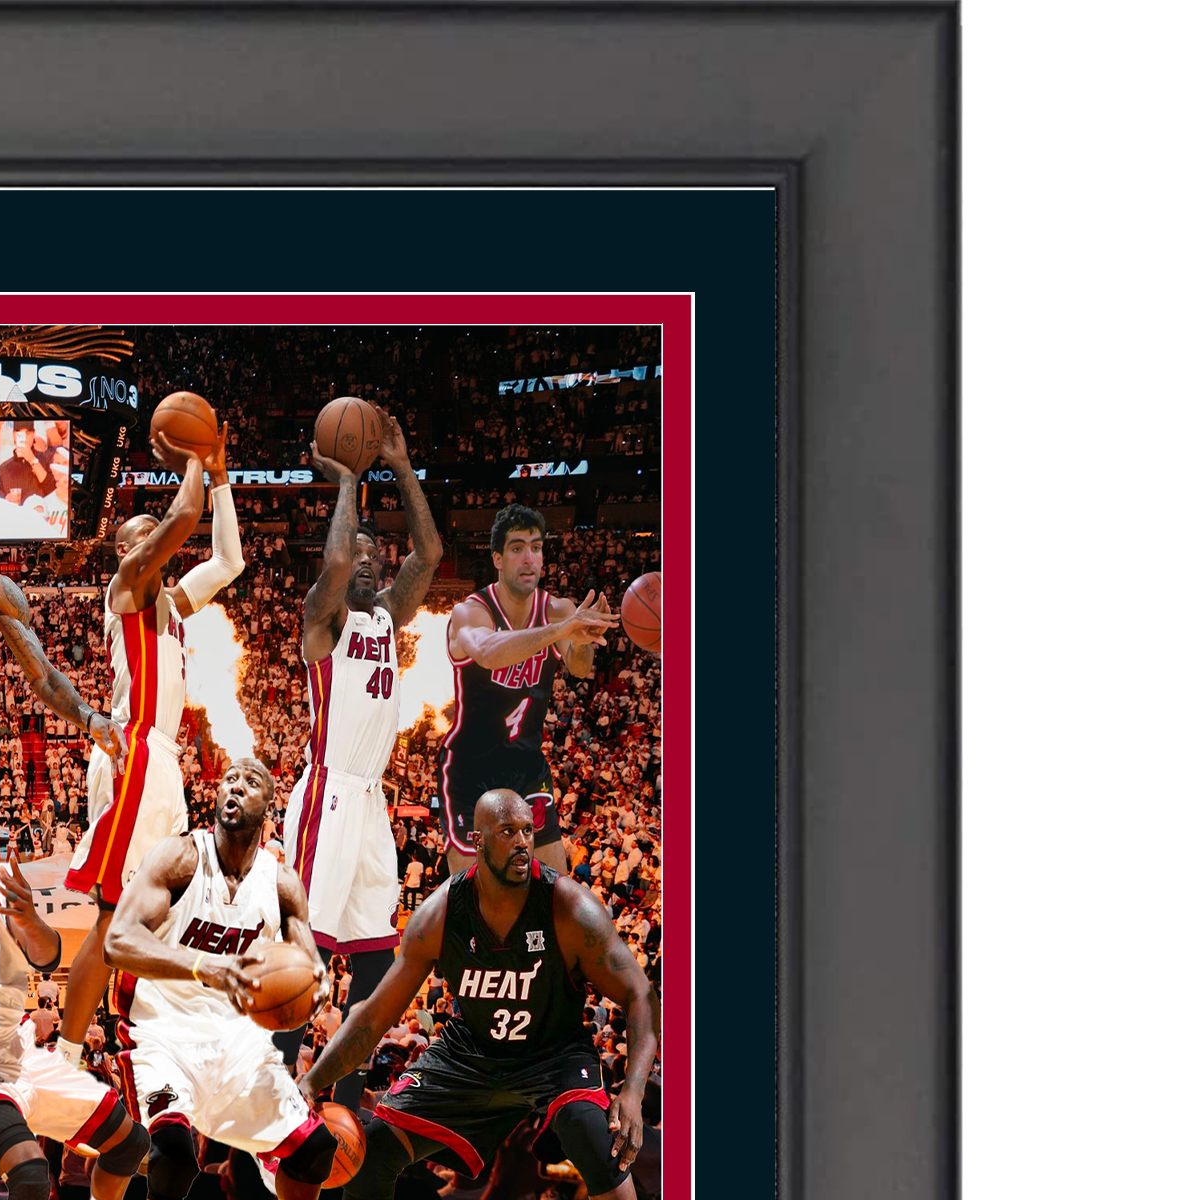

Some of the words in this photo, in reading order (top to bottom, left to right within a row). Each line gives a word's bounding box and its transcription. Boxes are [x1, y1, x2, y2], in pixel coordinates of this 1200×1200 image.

[117, 426, 127, 448] UKG
[110, 456, 120, 478] UKG
[203, 470, 314, 485] TRUS
[368, 469, 427, 482] NO.1
[104, 487, 114, 508] UKG
[98, 517, 108, 538] UKG
[366, 666, 394, 699] 40
[504, 697, 532, 742] 4
[179, 917, 265, 956] HEAT
[458, 957, 542, 1001] HEAT
[490, 1009, 531, 1041] 32
